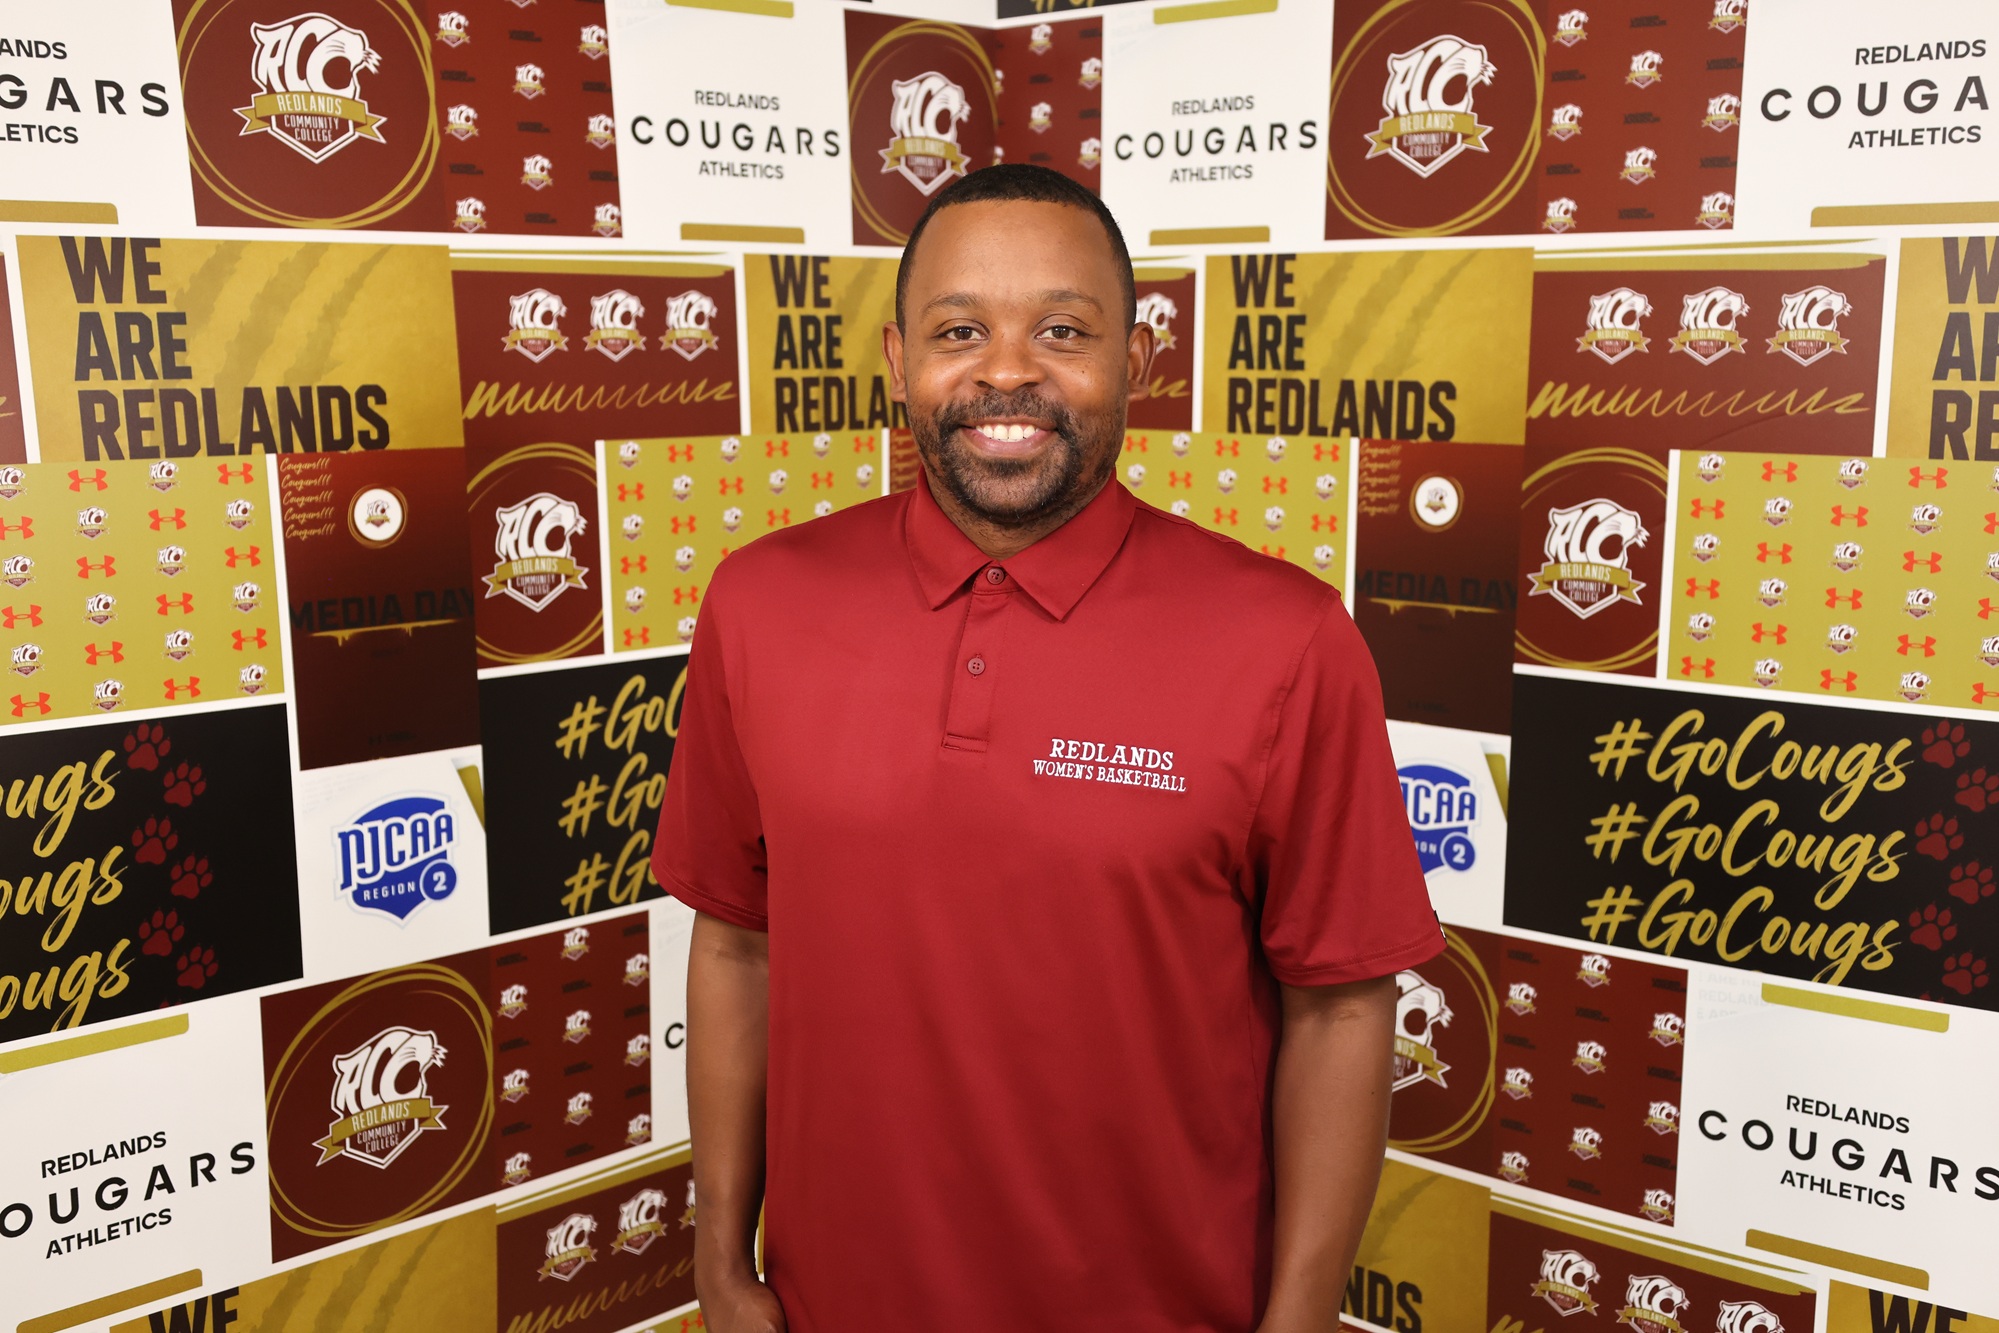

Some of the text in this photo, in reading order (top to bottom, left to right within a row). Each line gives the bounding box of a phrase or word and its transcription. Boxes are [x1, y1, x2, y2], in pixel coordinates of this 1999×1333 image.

[1854, 39, 1987, 66] REDLANDS
[276, 93, 342, 114] REDLANDS
[694, 90, 781, 111] REDLANDS
[1172, 95, 1255, 116] REDLANDS
[1760, 75, 1990, 122] COUGA
[284, 114, 339, 130] COMMUNITY
[295, 128, 333, 142] COLLEGE
[630, 115, 841, 158] COUGARS
[1399, 112, 1455, 133] REDLANDS
[1848, 125, 1982, 150] ATHLETICS
[1114, 121, 1319, 161] COUGARS
[1403, 132, 1450, 147] COMMUNITY
[698, 160, 785, 180] ATHLETICS
[1169, 164, 1254, 183] ATHLETICS
[60, 236, 168, 304] WE
[769, 254, 832, 308] WE
[1231, 254, 1297, 308] WE
[74, 311, 192, 381] ARE
[773, 314, 843, 370] ARE
[1228, 314, 1307, 370] ARE
[1690, 328, 1726, 340] REDLANDS
[1788, 329, 1825, 340] REDLANDS
[77, 384, 390, 462] REDLANDS
[1227, 377, 1457, 442] REDLANDS
[512, 558, 558, 574] REDLANDS
[516, 574, 556, 588] COMMUNITY
[1560, 562, 1611, 581] REDLANDS
[523, 586, 551, 596] COLLEGE
[1562, 578, 1607, 593] COMMUNITY
[1569, 590, 1601, 603] COLLEGE
[1049, 738, 1174, 771] REDLANDS
[1589, 709, 1914, 822] #GoCougs
[1033, 759, 1187, 792] WOMEN'S BASKETBALL
[0, 749, 121, 858] ugs
[338, 812, 454, 891] NJCAA
[1452, 843, 1466, 864] 2
[1585, 794, 1908, 911] #GoCougs
[363, 870, 448, 903] REGION 2
[1581, 878, 1902, 987] #GoCougs
[352, 1101, 410, 1132] REDLANDS
[1786, 1094, 1911, 1134] REDLANDS
[357, 1121, 407, 1145] COMMUNITY
[366, 1137, 401, 1154] COLLEGE
[41, 1131, 167, 1179] REDLANDS
[1698, 1110, 1999, 1201] COUGARS
[0, 1142, 255, 1238] OUGARS
[1780, 1170, 1906, 1211] ATHLETICS
[46, 1208, 172, 1259] ATHLETICS
